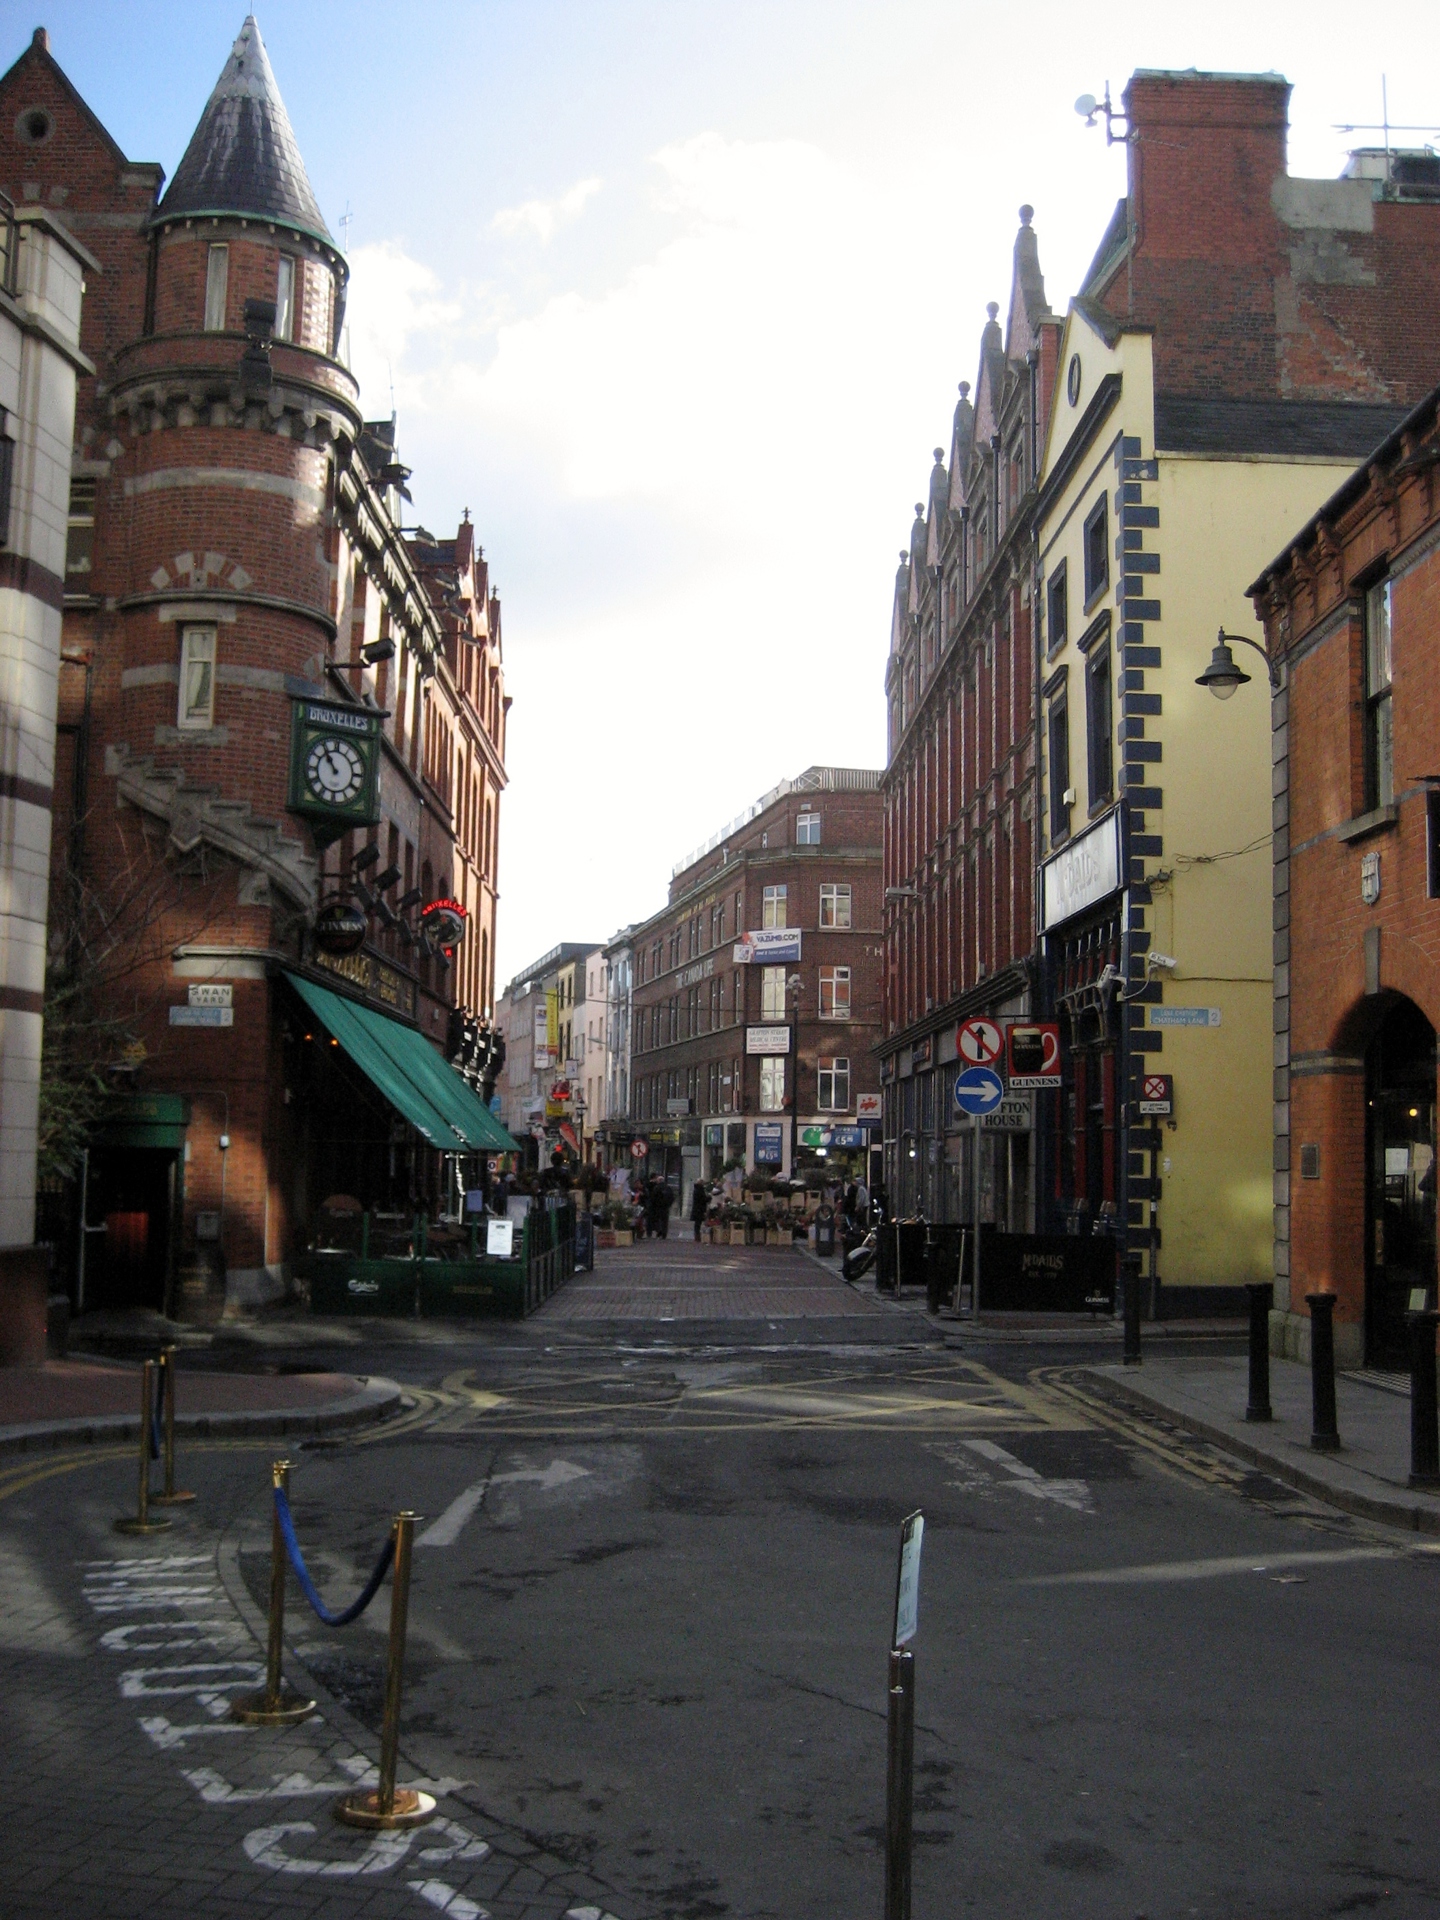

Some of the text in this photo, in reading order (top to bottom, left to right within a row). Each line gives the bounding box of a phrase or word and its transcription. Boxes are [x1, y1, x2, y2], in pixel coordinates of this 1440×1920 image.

[309, 706, 368, 731] BRUXELLES
[191, 987, 230, 996] SWAN
[1211, 1012, 1218, 1022] 2
[1012, 1077, 1059, 1087] GUINNESS
[1001, 1101, 1030, 1114] FTON
[985, 1115, 1023, 1126] HOUSE
